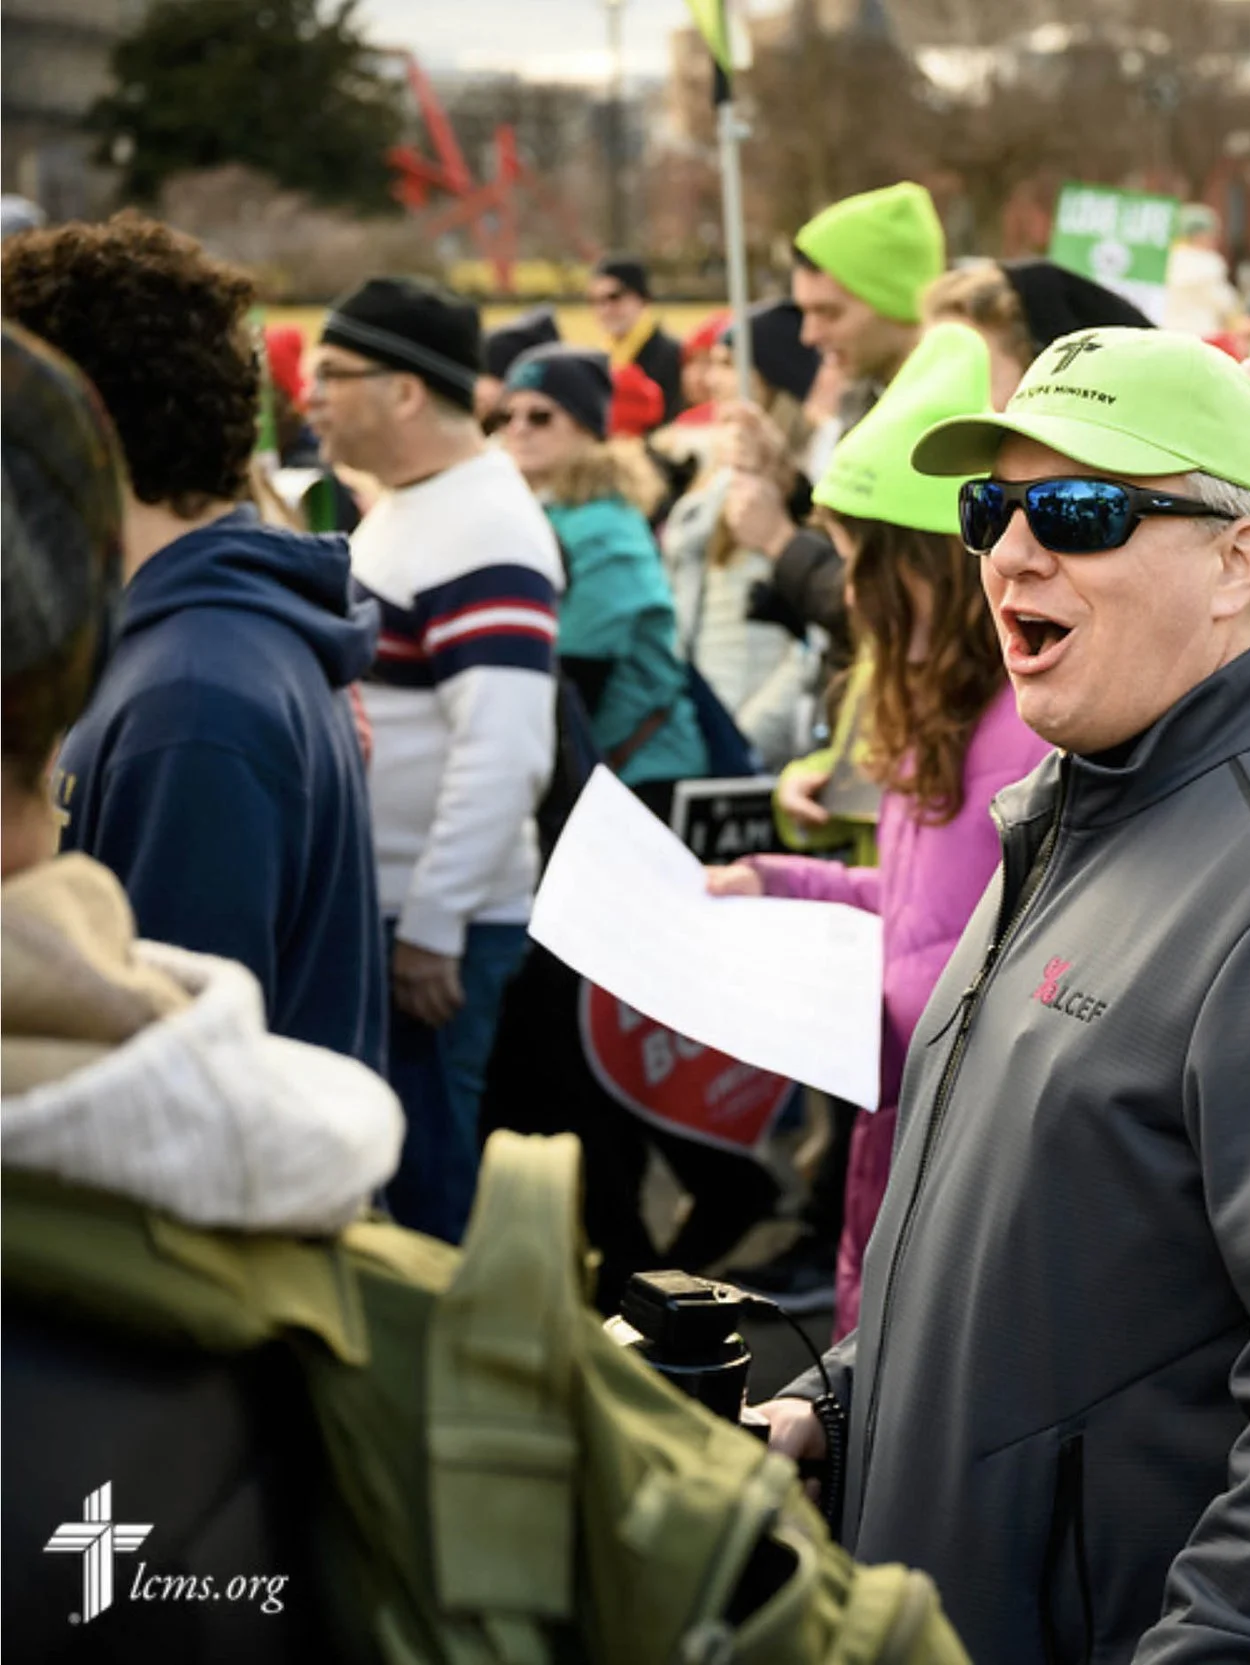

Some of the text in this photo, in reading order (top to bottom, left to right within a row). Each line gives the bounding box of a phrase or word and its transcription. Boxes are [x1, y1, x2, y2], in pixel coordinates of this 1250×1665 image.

[1053, 384, 1116, 405] MINISTRY
[691, 819, 771, 854] I AM
[1053, 985, 1107, 1023] LCEF
